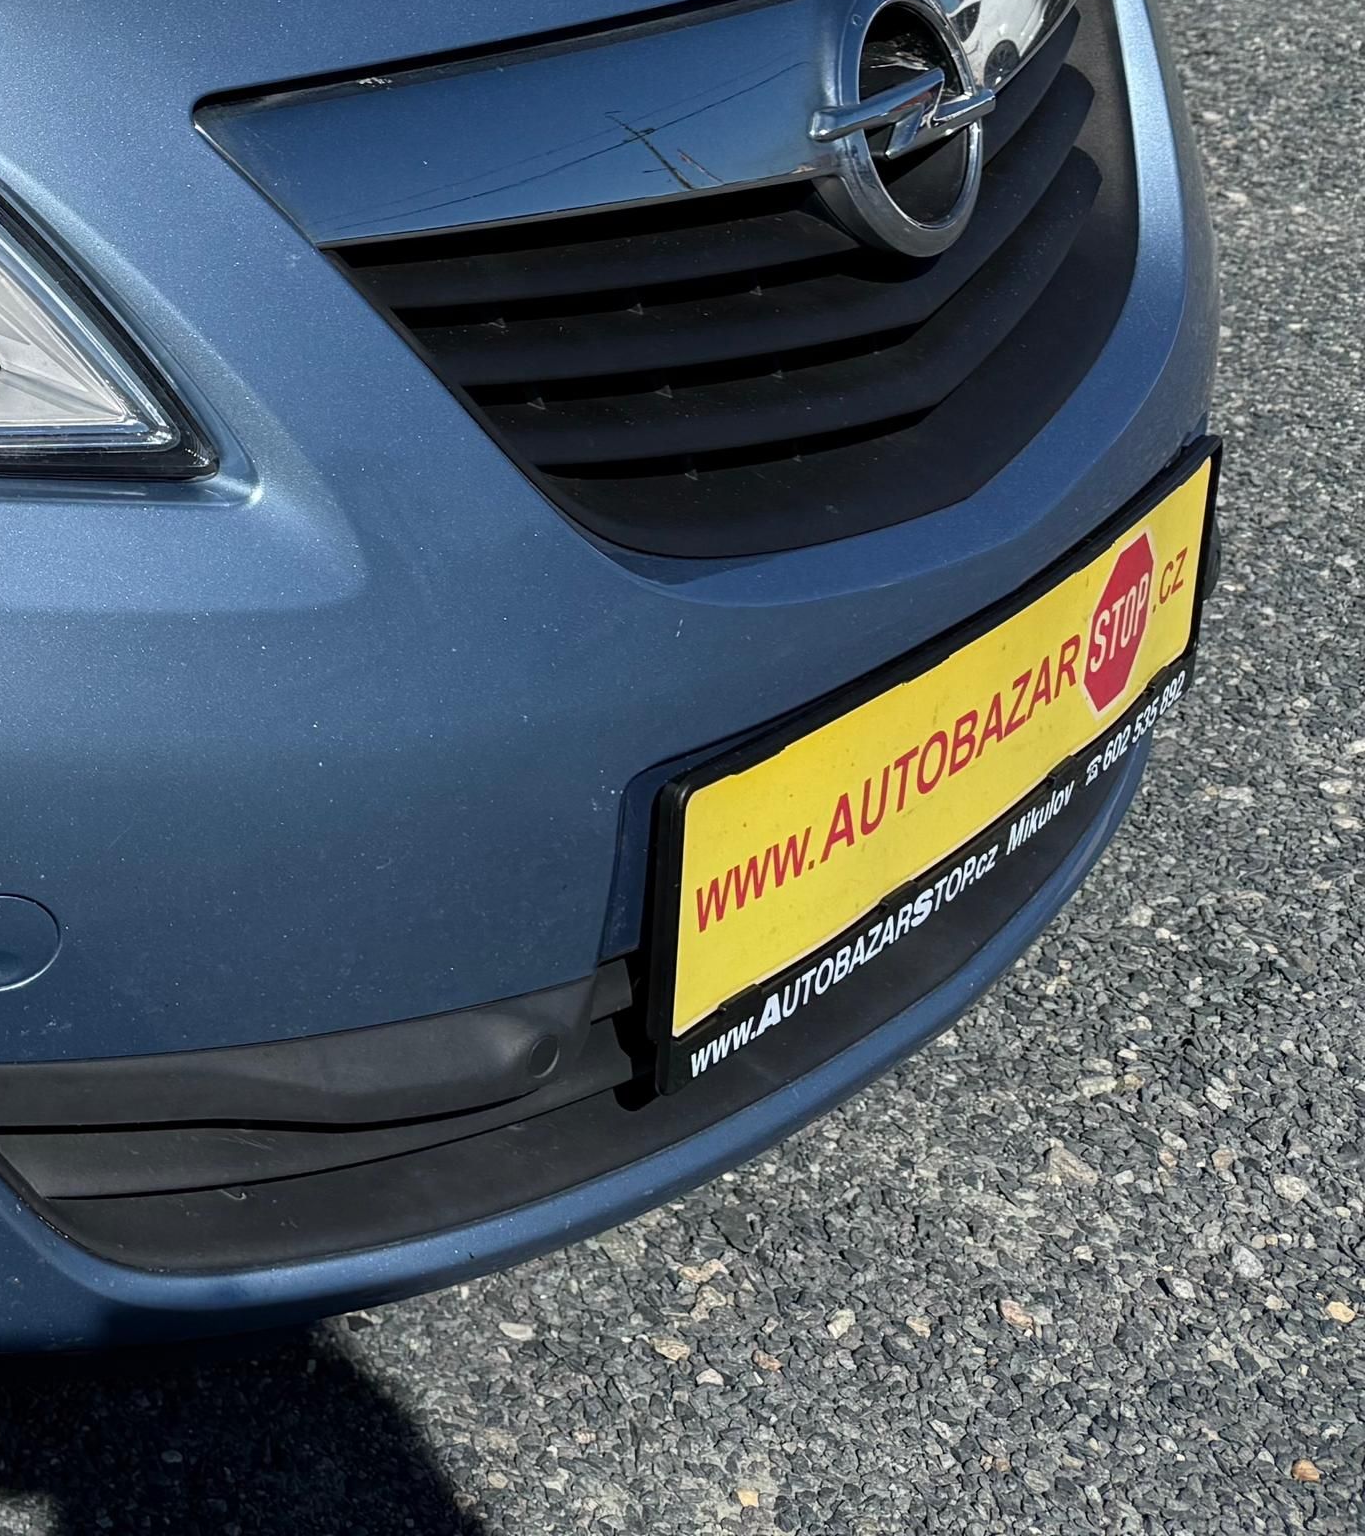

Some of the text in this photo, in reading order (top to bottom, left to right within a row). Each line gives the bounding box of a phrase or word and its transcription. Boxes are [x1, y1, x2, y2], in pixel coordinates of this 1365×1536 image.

[1005, 779, 1075, 856] Mikulov
[1102, 724, 1132, 771] 602
[1131, 696, 1160, 743] 535
[1159, 670, 1186, 715] 892
